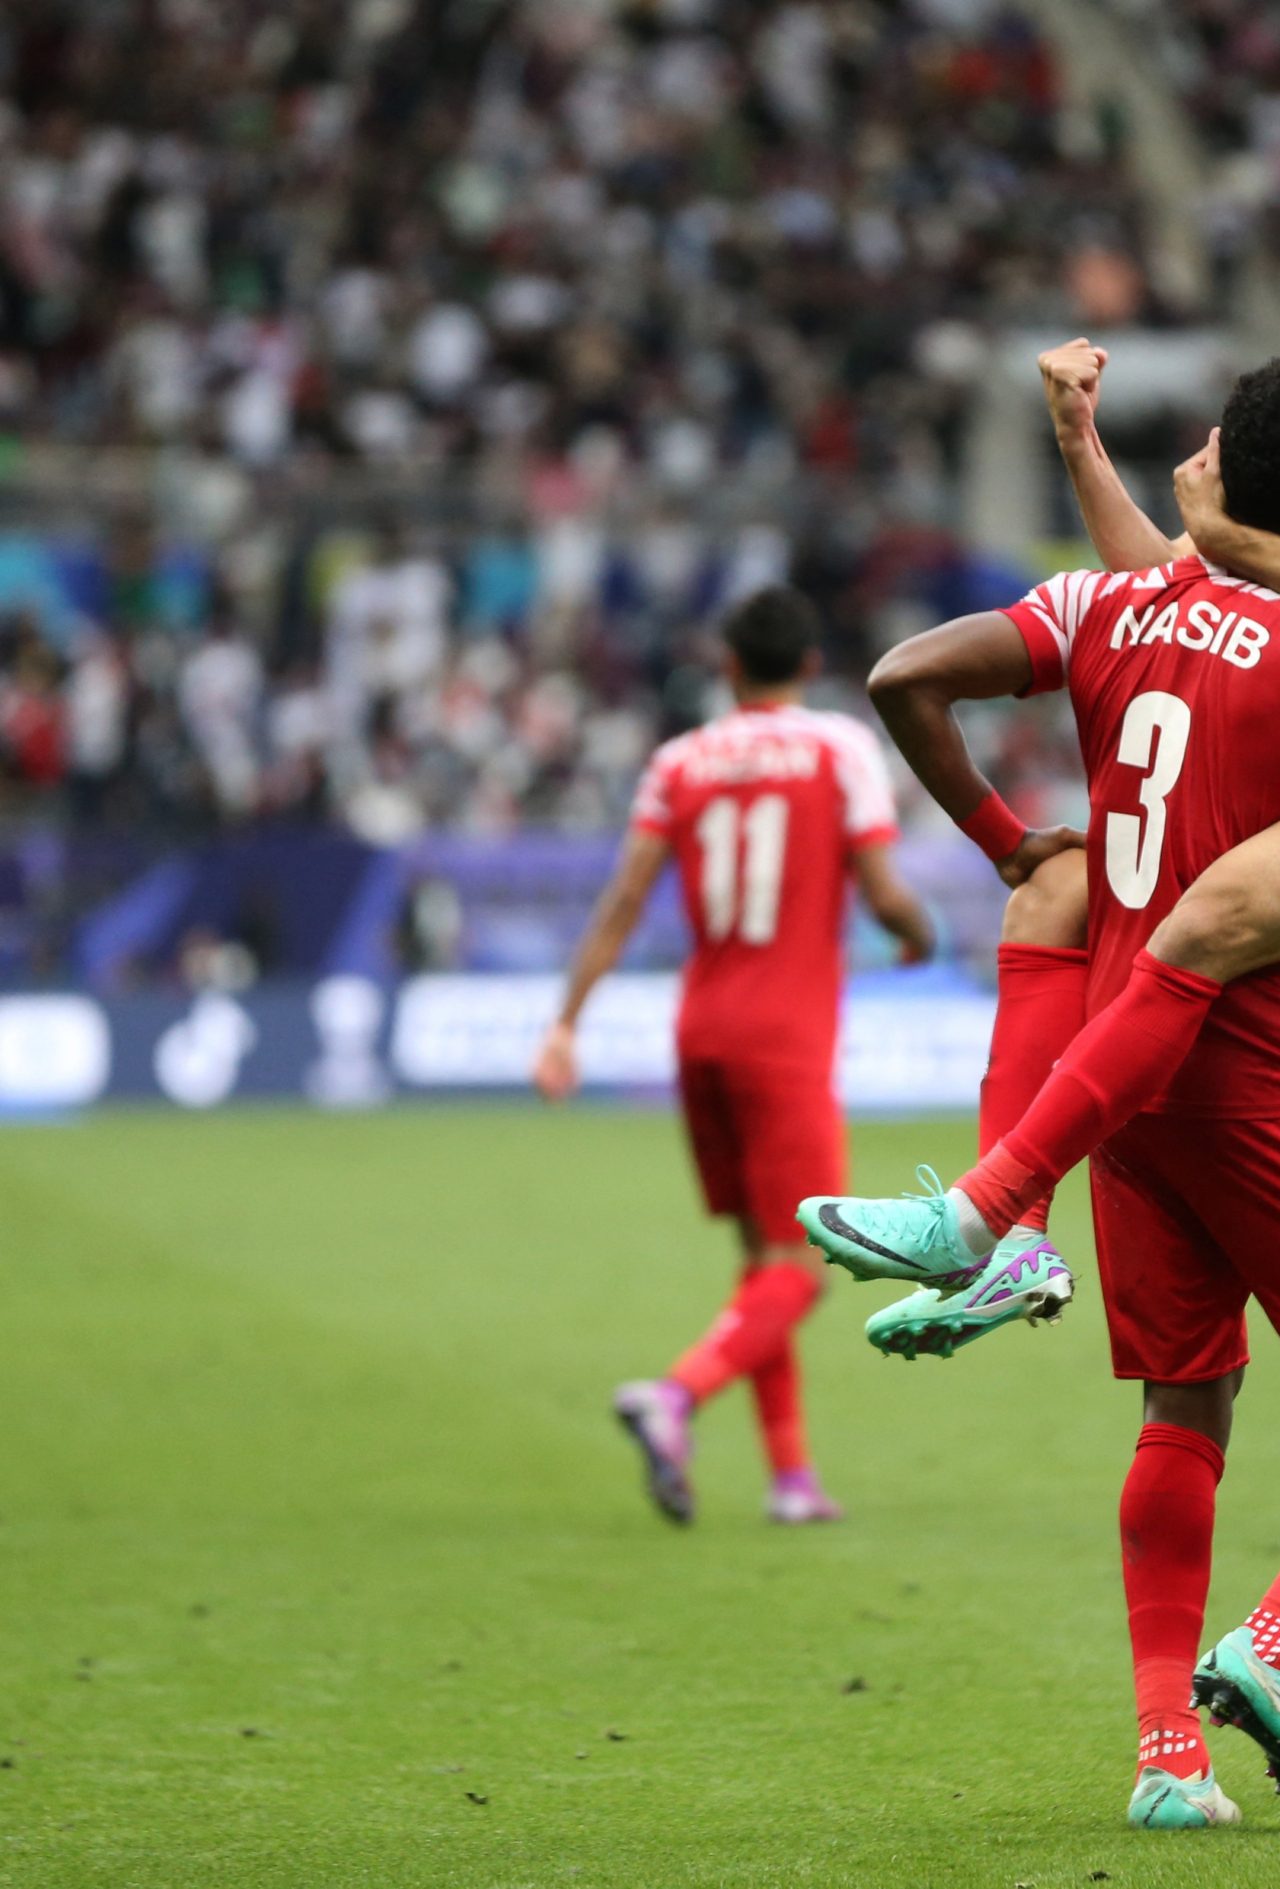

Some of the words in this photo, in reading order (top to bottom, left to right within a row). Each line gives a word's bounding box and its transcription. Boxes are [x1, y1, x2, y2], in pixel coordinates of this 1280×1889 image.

[1109, 600, 1271, 669] NASIB
[697, 795, 789, 945] 11
[1105, 691, 1191, 909] 3
